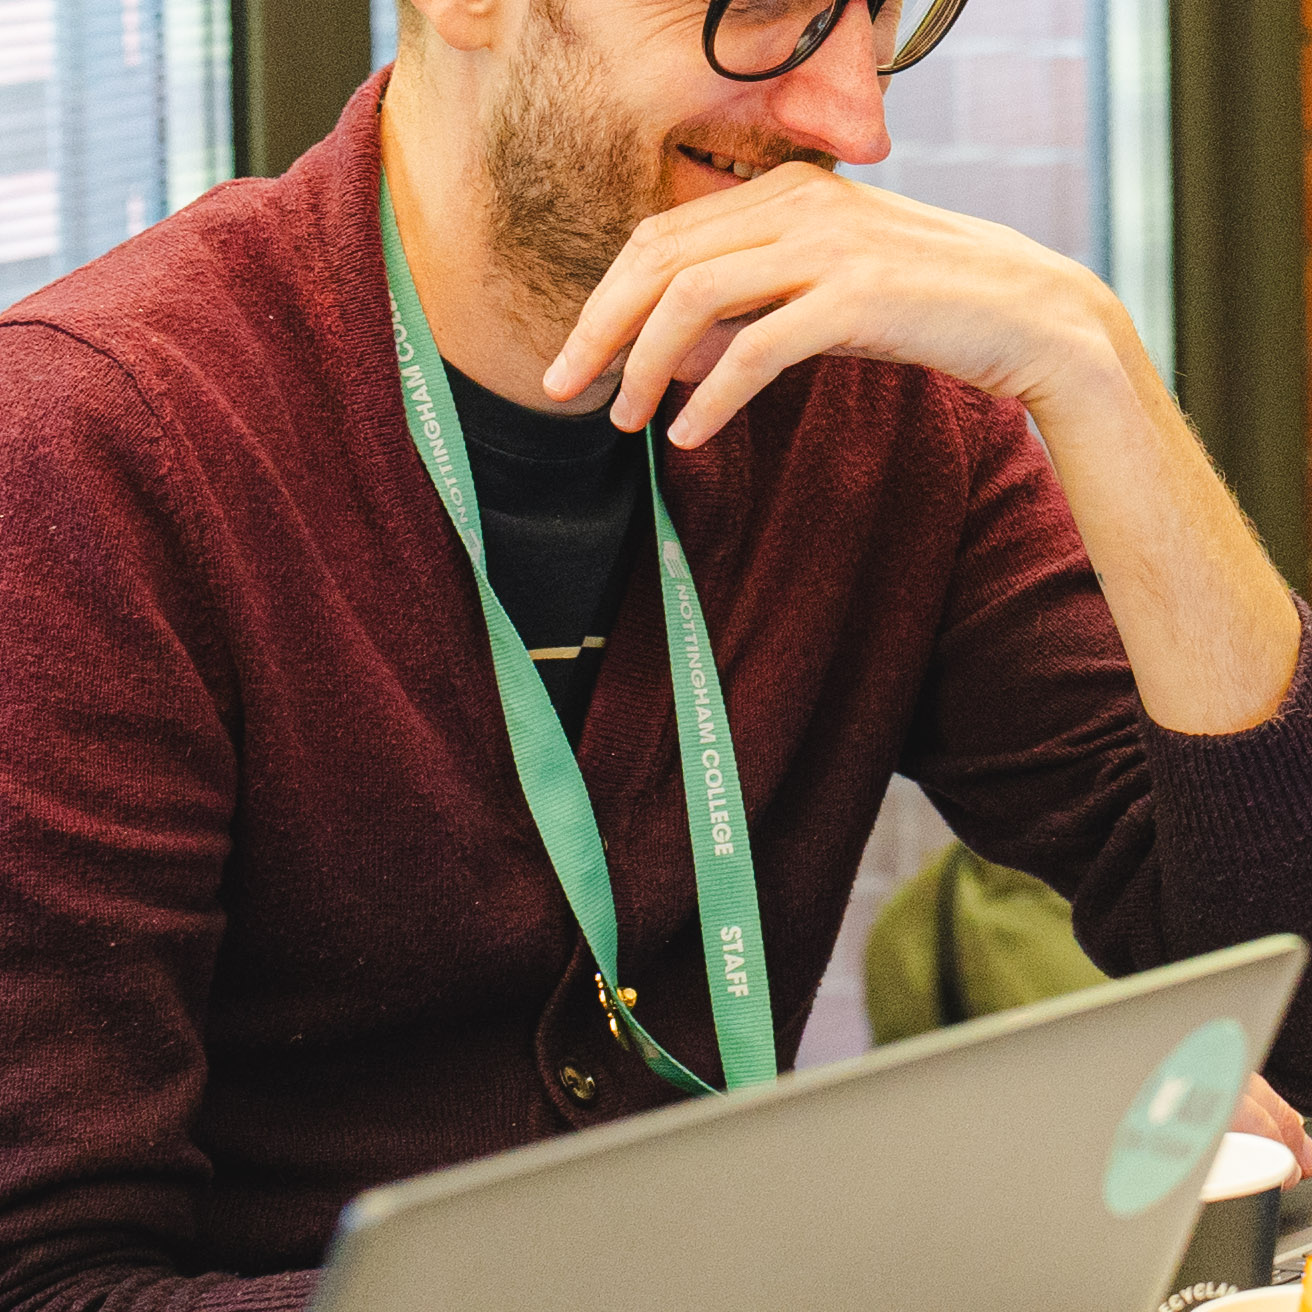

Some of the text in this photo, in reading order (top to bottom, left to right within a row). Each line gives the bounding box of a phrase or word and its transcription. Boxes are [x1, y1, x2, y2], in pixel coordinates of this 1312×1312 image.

[400, 365, 469, 524] NOTTINGHAM
[675, 584, 735, 857] NOTTINGHAM COLLEGE
[720, 925, 750, 999] STAFF
